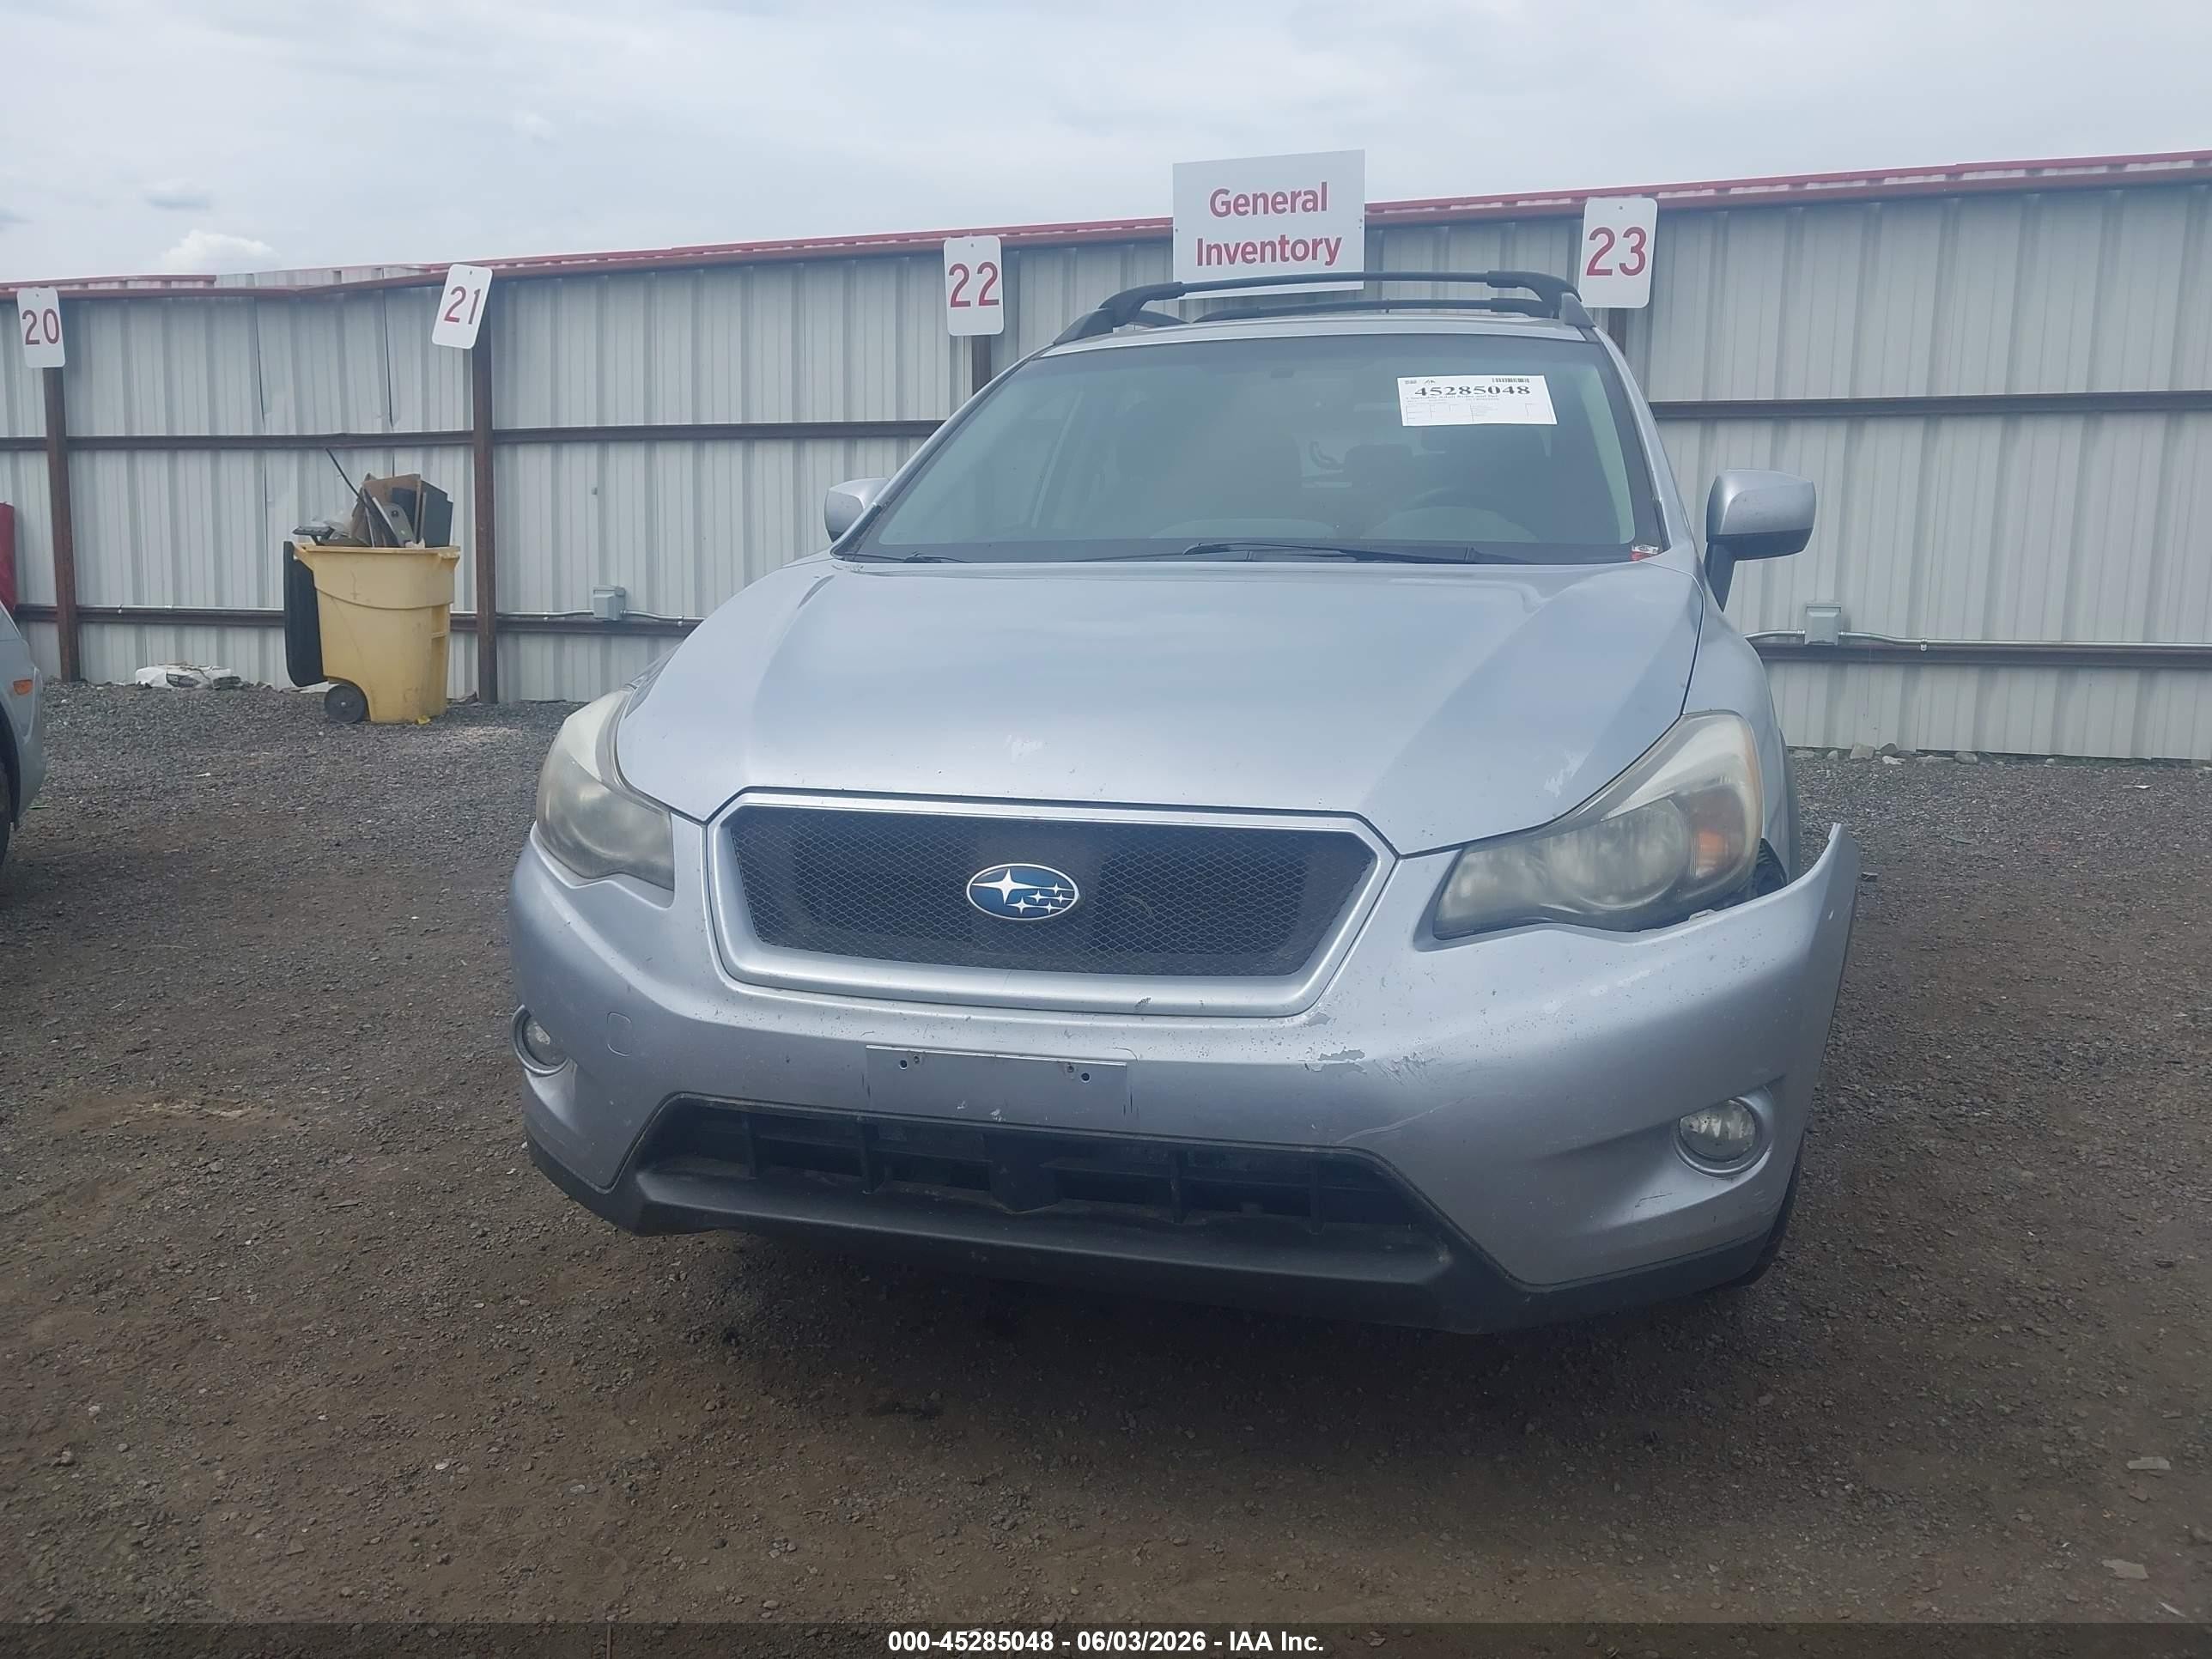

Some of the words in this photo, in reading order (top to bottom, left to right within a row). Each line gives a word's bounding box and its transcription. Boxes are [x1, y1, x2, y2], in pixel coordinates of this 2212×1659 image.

[1209, 181, 1328, 218] General
[1196, 234, 1342, 266] Inventory
[1586, 227, 1648, 276] 23
[948, 261, 1000, 309] 22
[443, 285, 482, 325] 21
[21, 308, 60, 345] 20
[1414, 385, 1531, 397] 45285048
